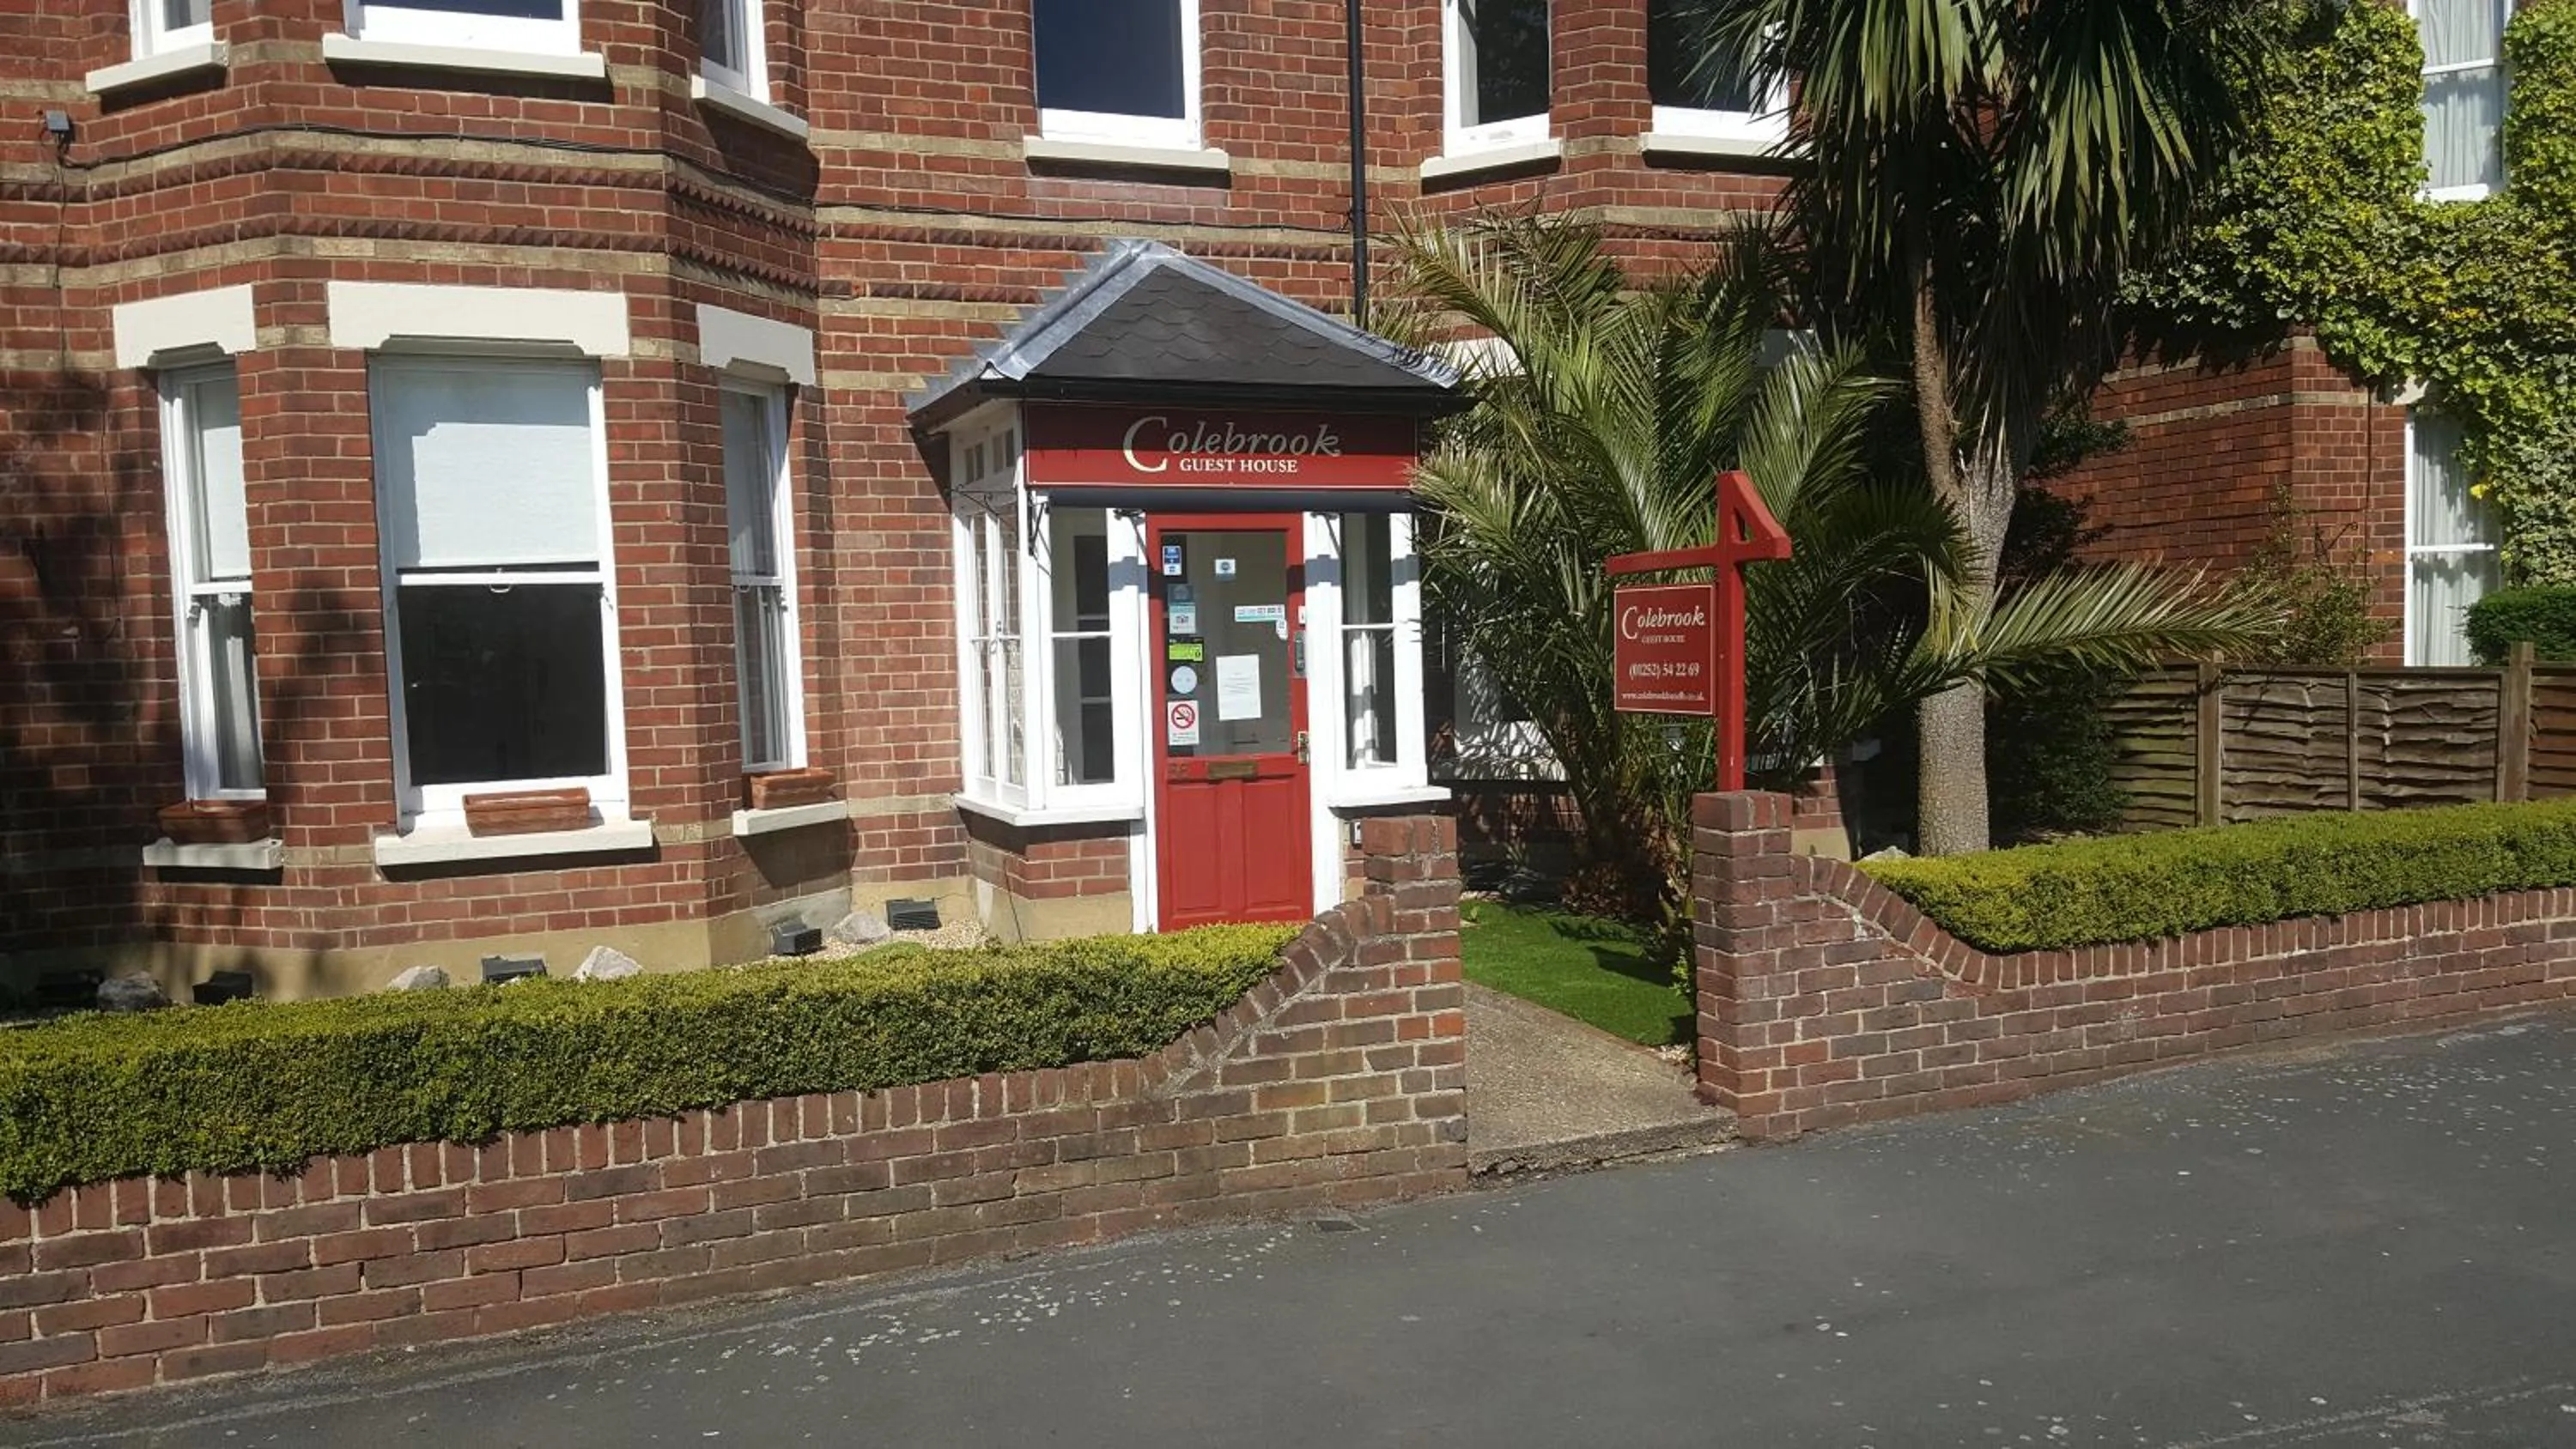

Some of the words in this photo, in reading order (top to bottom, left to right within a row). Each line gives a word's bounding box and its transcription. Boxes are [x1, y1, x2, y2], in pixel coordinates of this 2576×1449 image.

[1123, 416, 1340, 471] Colebrook
[1179, 458, 1235, 471] GUEST
[1241, 459, 1297, 473] HOUSE
[1622, 605, 1704, 640] Colebrook
[1662, 662, 1674, 676] 54
[1675, 662, 1686, 676] 22
[1687, 662, 1699, 677] 69
